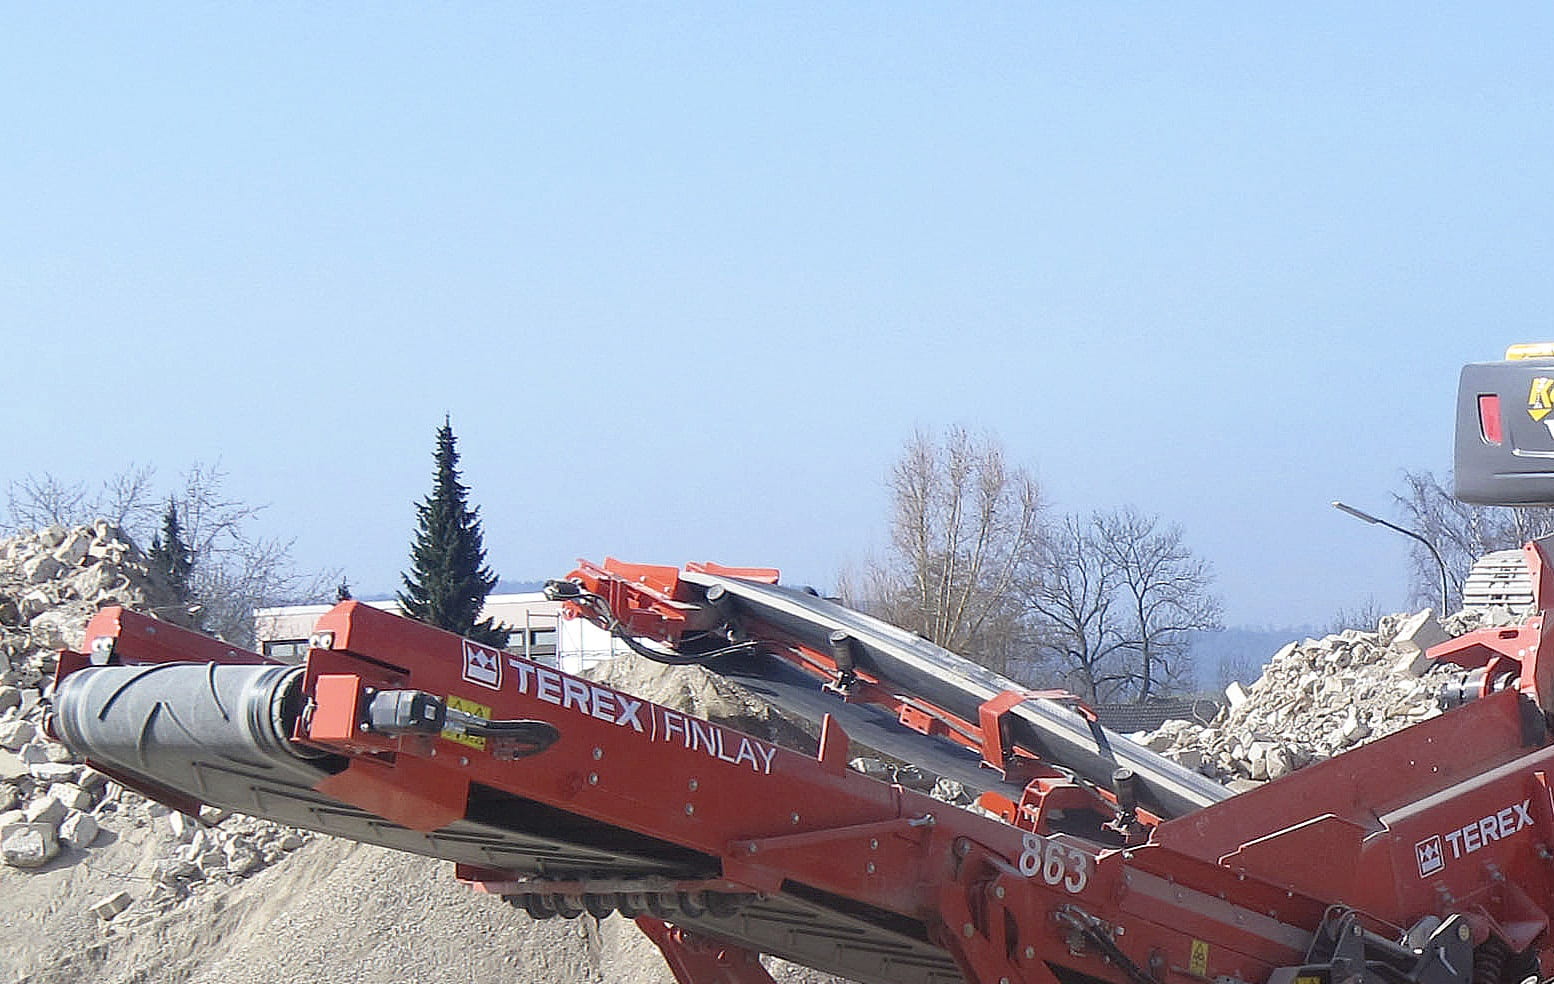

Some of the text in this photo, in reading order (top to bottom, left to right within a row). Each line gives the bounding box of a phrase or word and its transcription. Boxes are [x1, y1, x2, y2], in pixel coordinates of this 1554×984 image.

[508, 658, 777, 775] TEREX FINLAY
[1445, 798, 1536, 860] TEREX
[1018, 833, 1088, 894] 863
